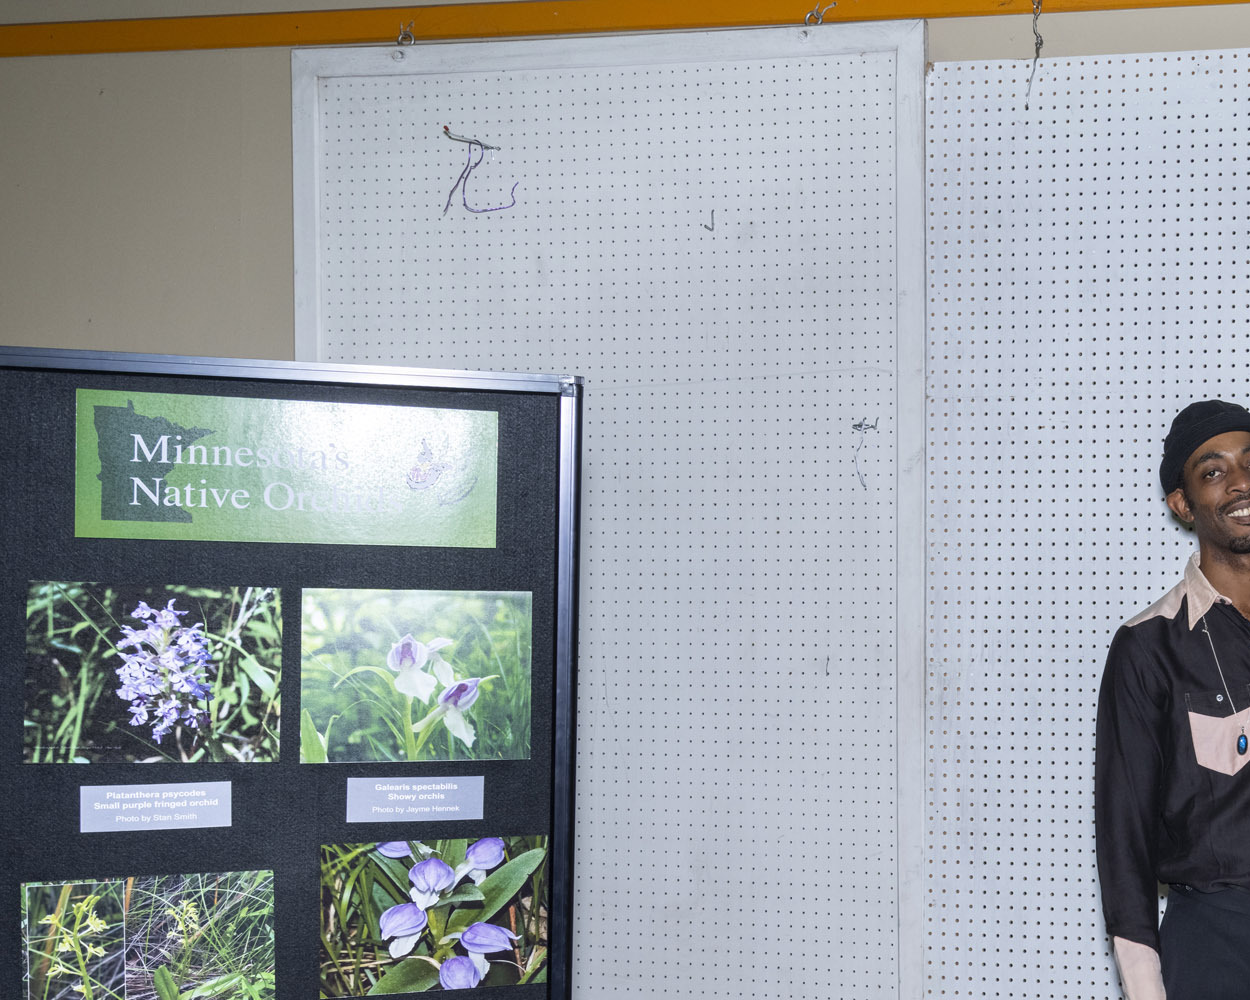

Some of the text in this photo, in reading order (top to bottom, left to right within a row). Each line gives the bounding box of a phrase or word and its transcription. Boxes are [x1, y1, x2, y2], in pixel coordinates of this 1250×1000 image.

[130, 434, 349, 470] Minnesota's
[129, 477, 403, 512] Native Orchids
[375, 783, 458, 792] Galearis spectabilis
[106, 790, 206, 799] Platanthera psycodes
[388, 792, 445, 802] Showy orchis
[94, 798, 218, 810] Small purple fringed orchid
[395, 806, 404, 814] by
[406, 806, 430, 814] Jayme
[142, 814, 151, 823] by
